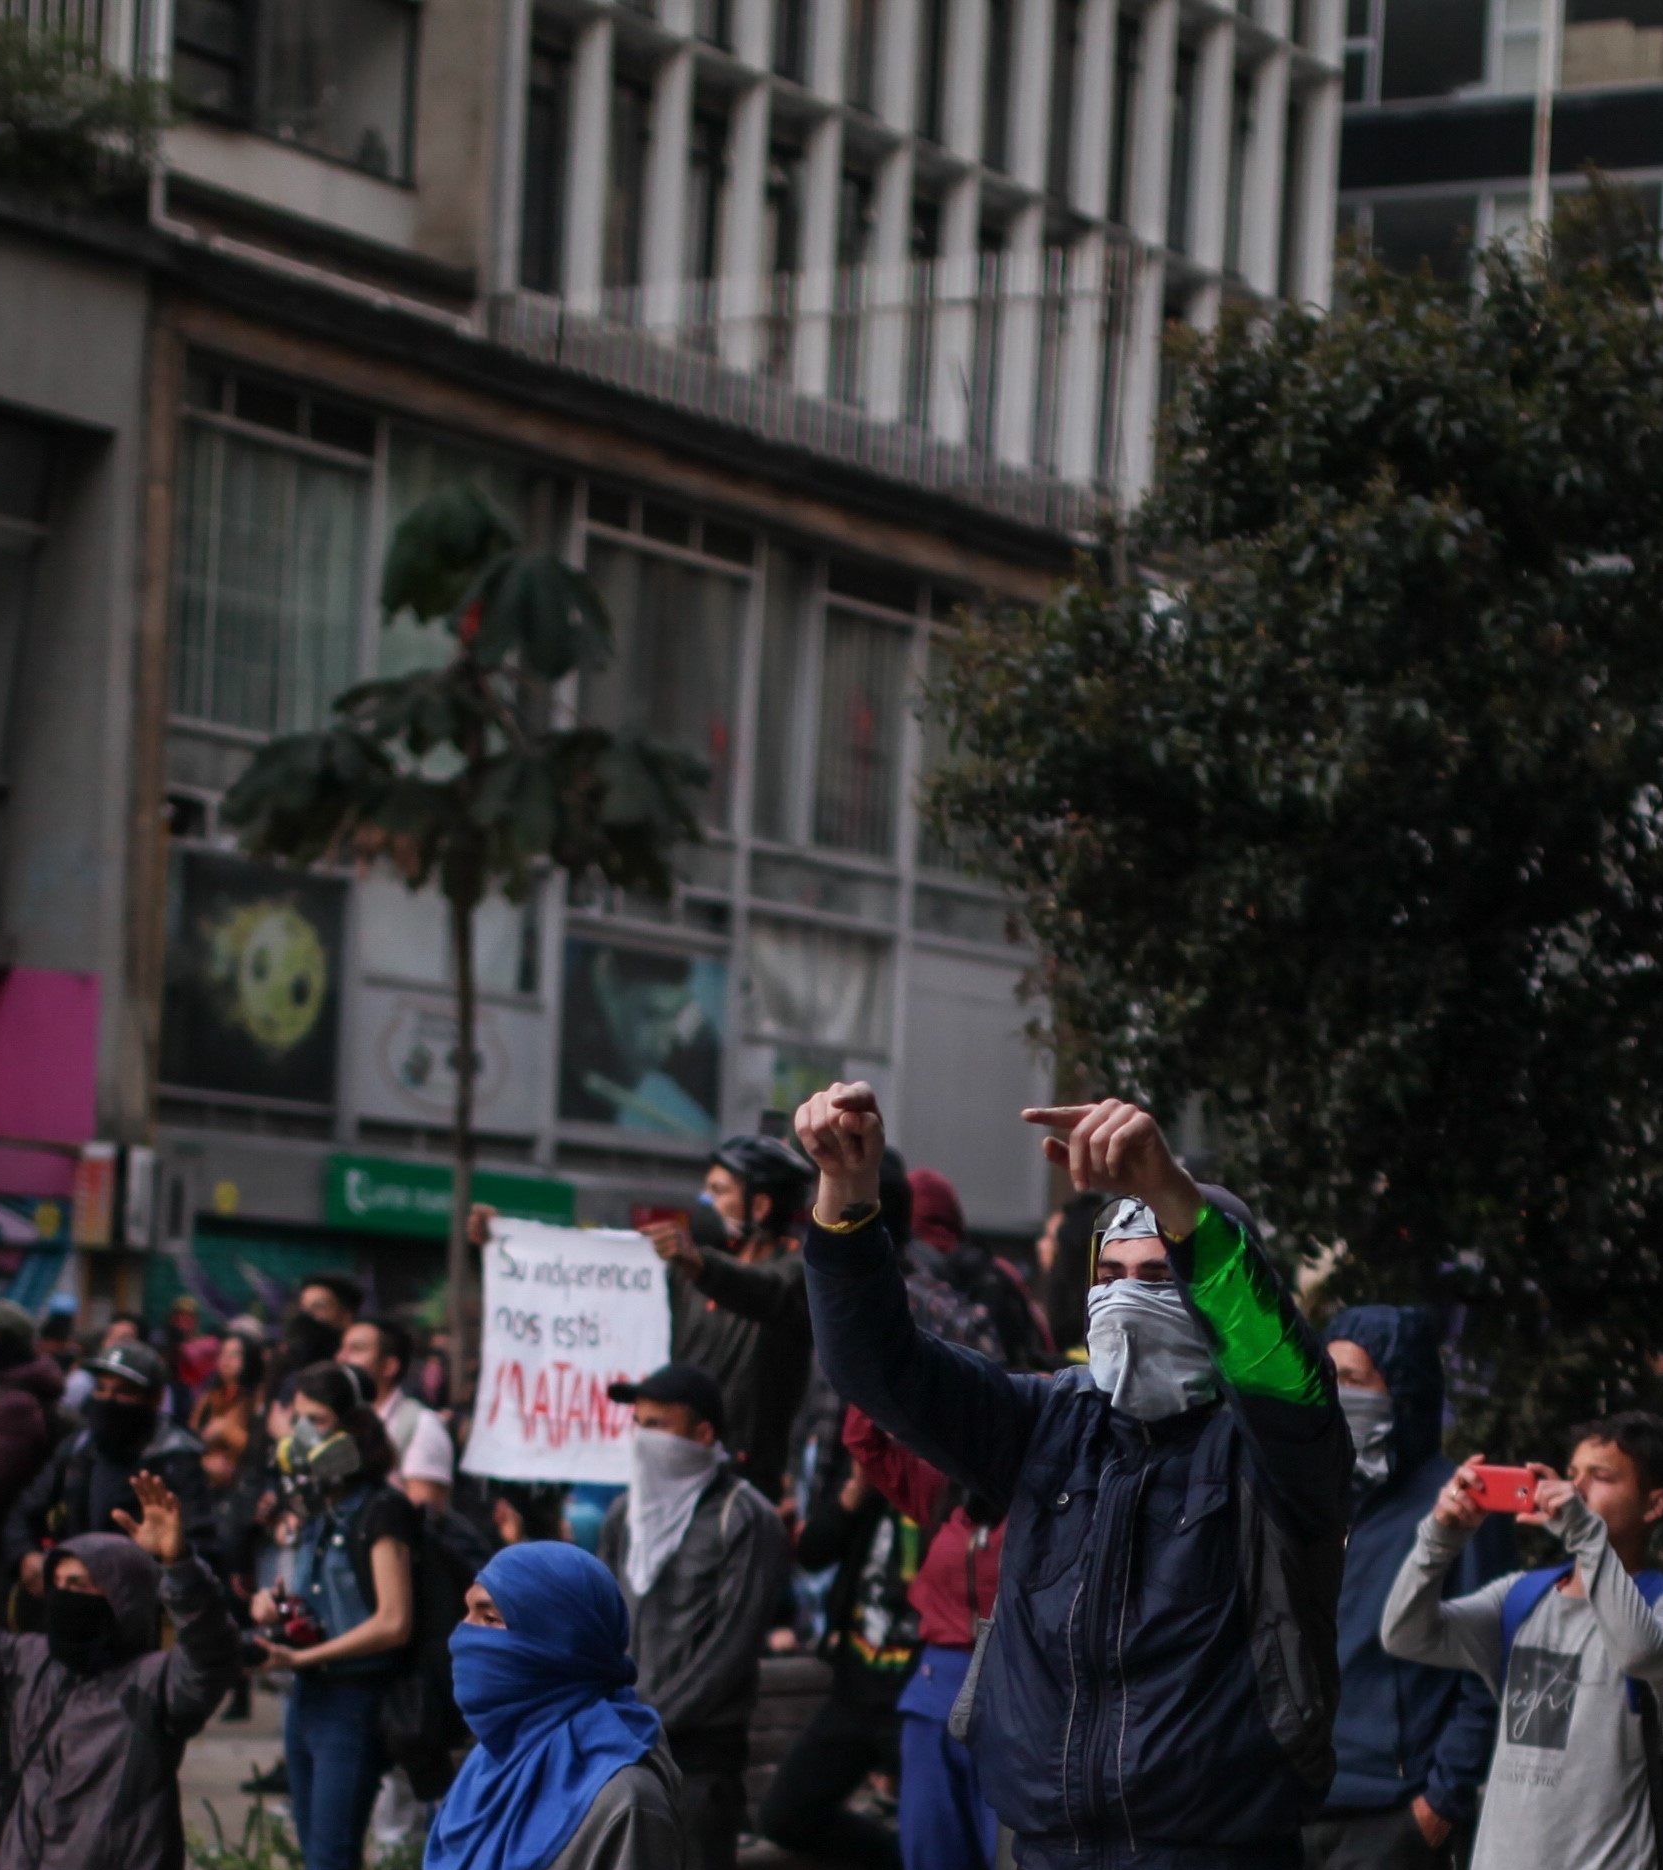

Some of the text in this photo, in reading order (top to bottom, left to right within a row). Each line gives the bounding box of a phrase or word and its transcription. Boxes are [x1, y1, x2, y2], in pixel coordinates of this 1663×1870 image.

[498, 1235, 527, 1281] Su
[496, 1307, 541, 1345] nos
[488, 1360, 649, 1448] MATAND
